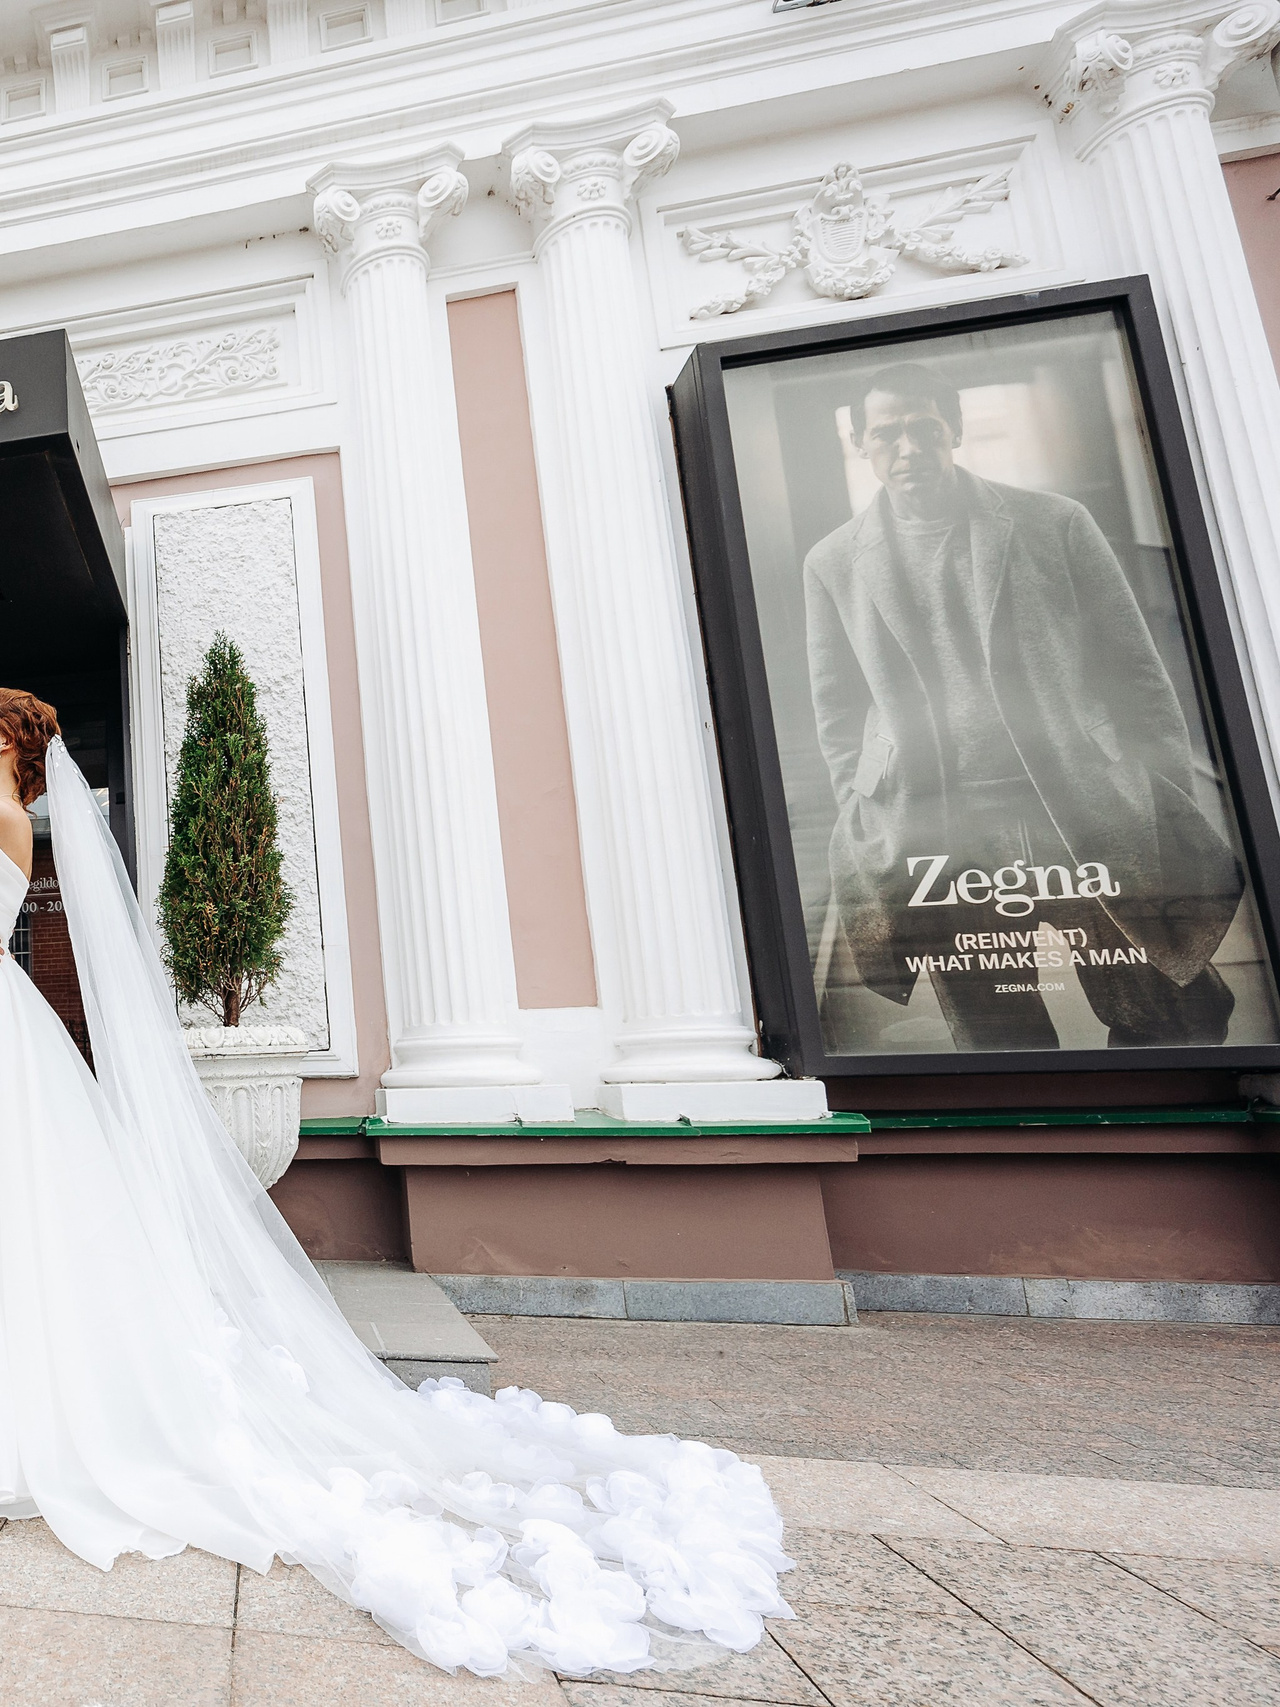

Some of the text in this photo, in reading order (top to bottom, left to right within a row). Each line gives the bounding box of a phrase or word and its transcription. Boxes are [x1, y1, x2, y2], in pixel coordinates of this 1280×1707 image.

[906, 855, 1120, 917] Zegna
[955, 928, 1087, 951] (REINVENT)
[905, 948, 1148, 972] WHAT MAKES A MAN
[995, 983, 1065, 993] ZEGNA.COM
